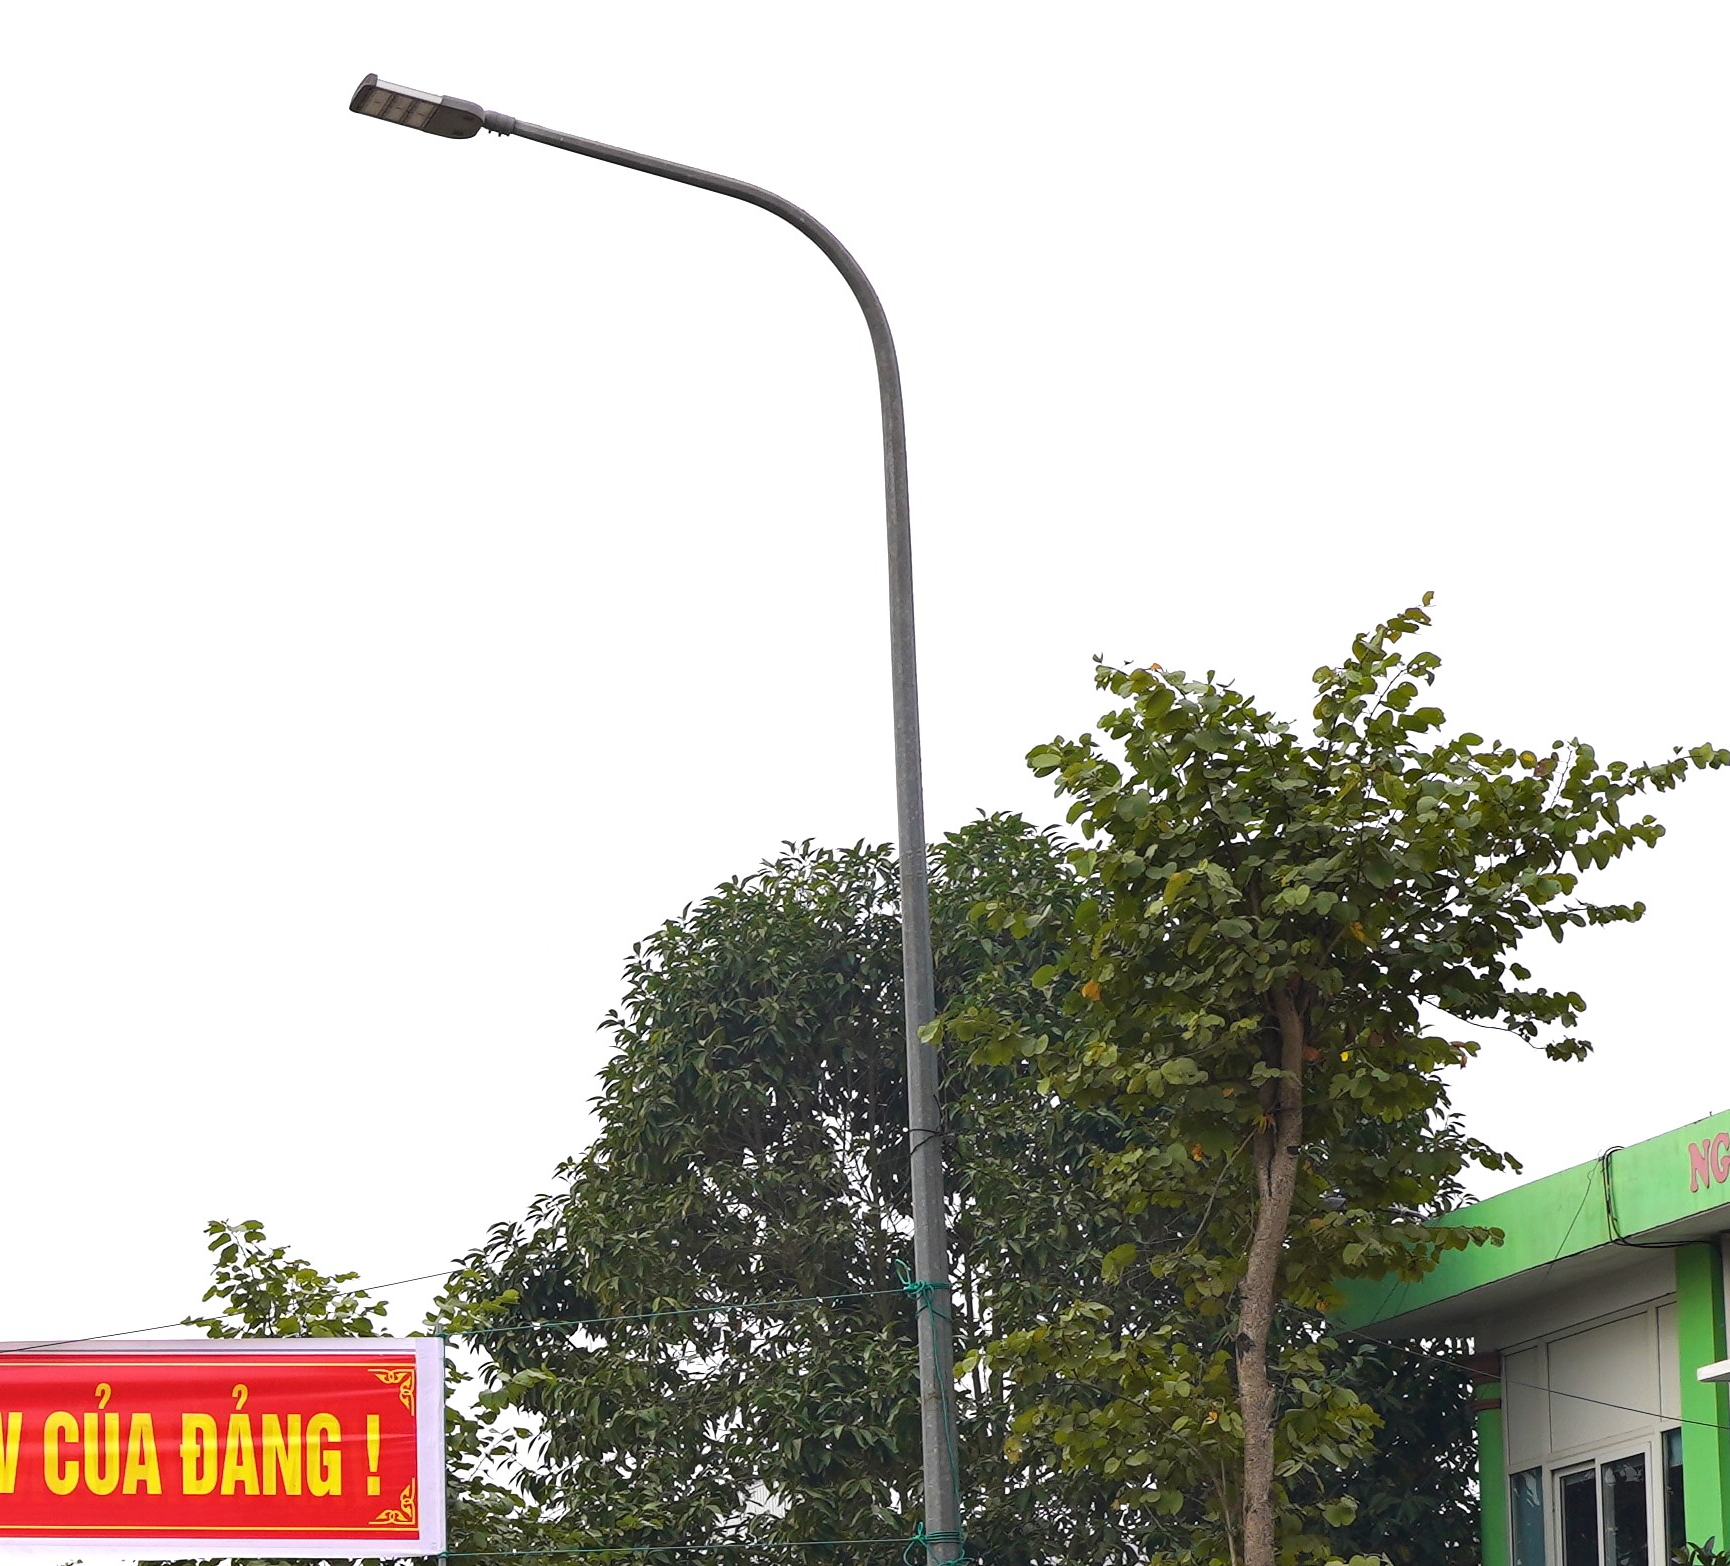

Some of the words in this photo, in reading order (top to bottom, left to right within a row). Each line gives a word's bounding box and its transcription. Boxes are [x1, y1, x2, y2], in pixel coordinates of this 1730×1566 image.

[43, 1383, 162, 1496] CỦA
[179, 1384, 342, 1497] ĐẢNG
[366, 1414, 380, 1496] !
